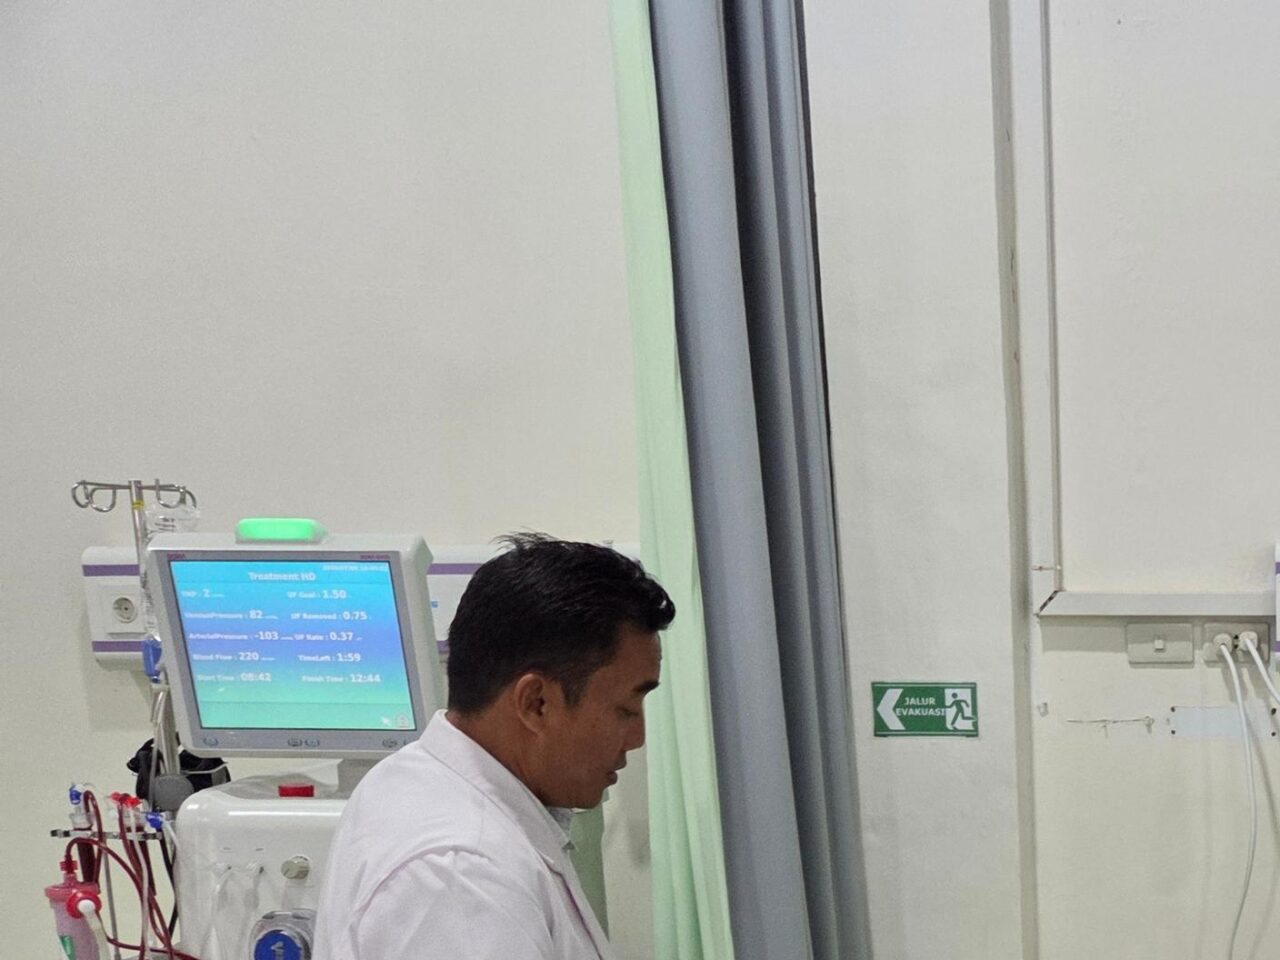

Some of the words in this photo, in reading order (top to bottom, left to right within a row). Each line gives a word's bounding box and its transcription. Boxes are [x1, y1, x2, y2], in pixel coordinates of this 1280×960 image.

[248, 572, 300, 581] Treatment
[300, 572, 317, 581] HD
[202, 588, 210, 598] 2
[323, 589, 347, 599] 1.50
[249, 609, 263, 619] 82
[342, 610, 368, 620] 0.75
[255, 630, 279, 640] -103
[306, 633, 324, 641] Rate
[329, 631, 354, 641] 0.37
[238, 651, 260, 661] 220
[337, 652, 361, 662] 1:59
[240, 671, 273, 682] 08:42
[326, 674, 345, 682] Time
[350, 673, 382, 683] 12:44
[904, 697, 937, 706] JALUR
[895, 707, 946, 717] EVAKUASI
